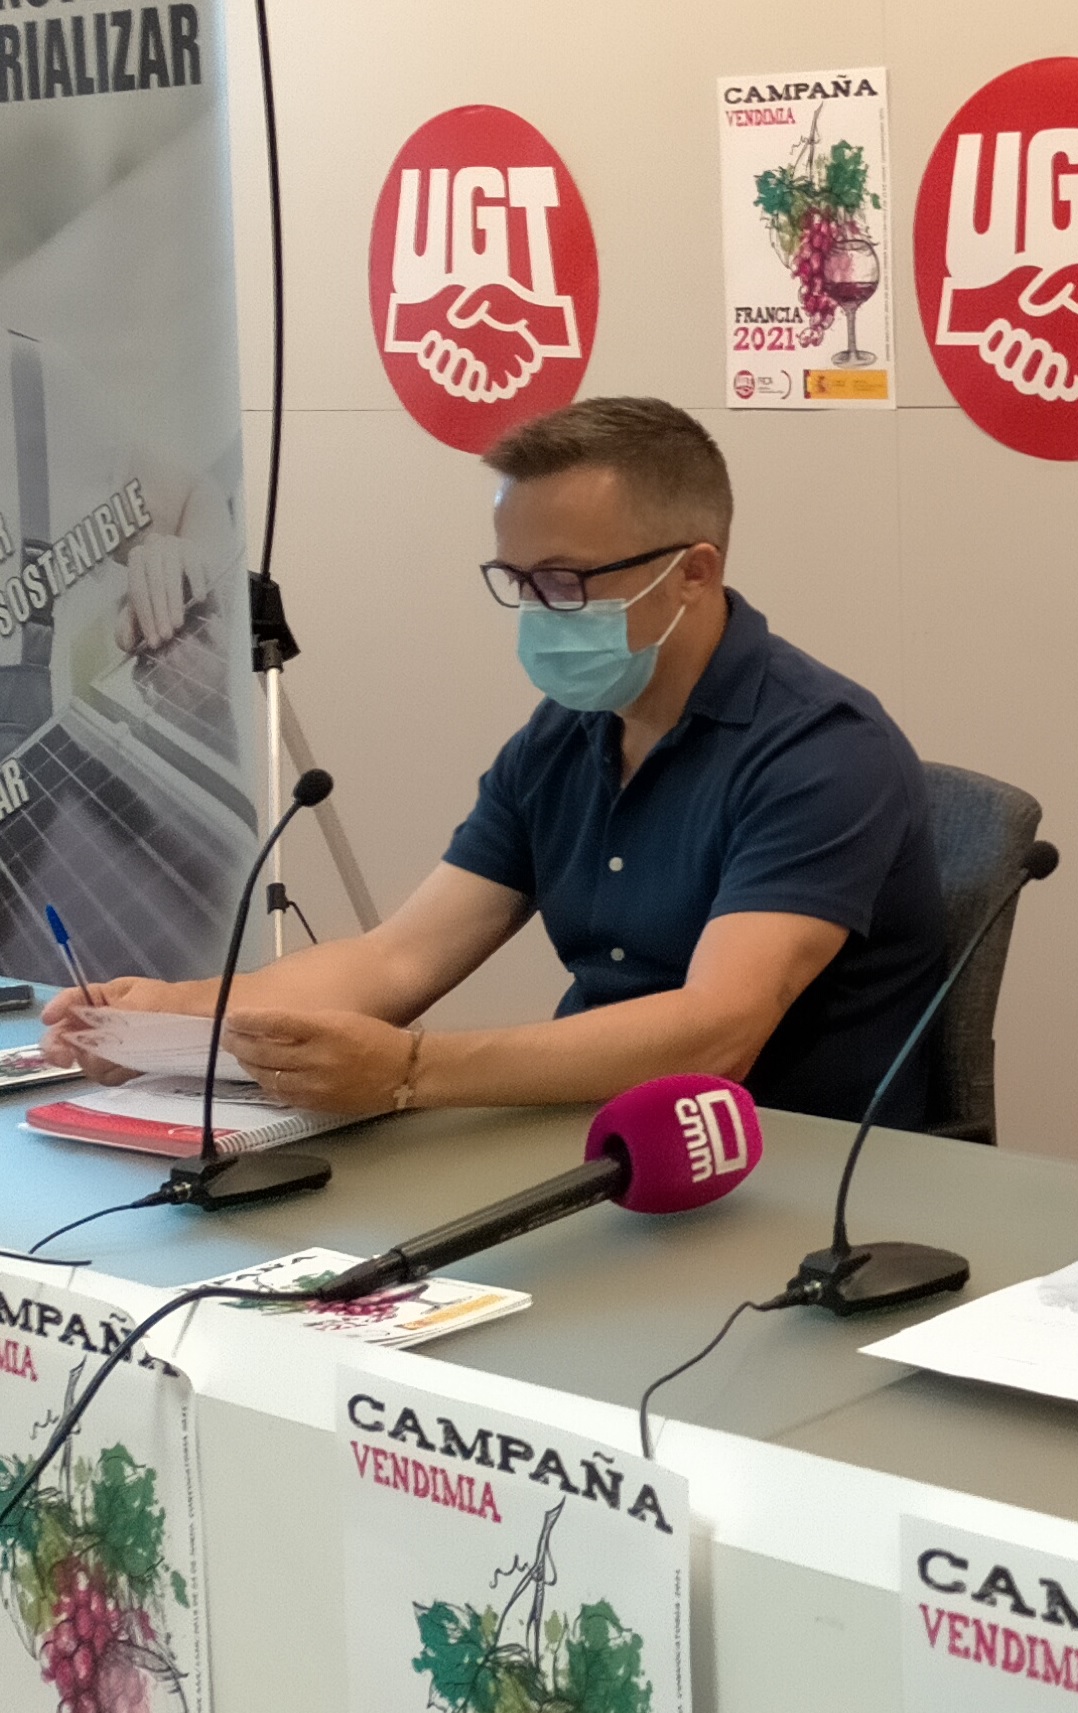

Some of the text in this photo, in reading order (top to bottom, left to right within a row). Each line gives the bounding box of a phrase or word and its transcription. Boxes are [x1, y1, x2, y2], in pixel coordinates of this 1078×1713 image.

[0, 3, 201, 103] RIALIZAR
[724, 74, 878, 105] CAMPAÑA
[392, 166, 560, 297] UGT
[733, 326, 796, 351] 2021
[735, 306, 803, 323] FRANCIA
[0, 478, 153, 637] SOSTENIBLE
[674, 1098, 714, 1183] cmm
[347, 1393, 674, 1534] CAMPAÑA
[350, 1440, 503, 1524] VENDIMIA
